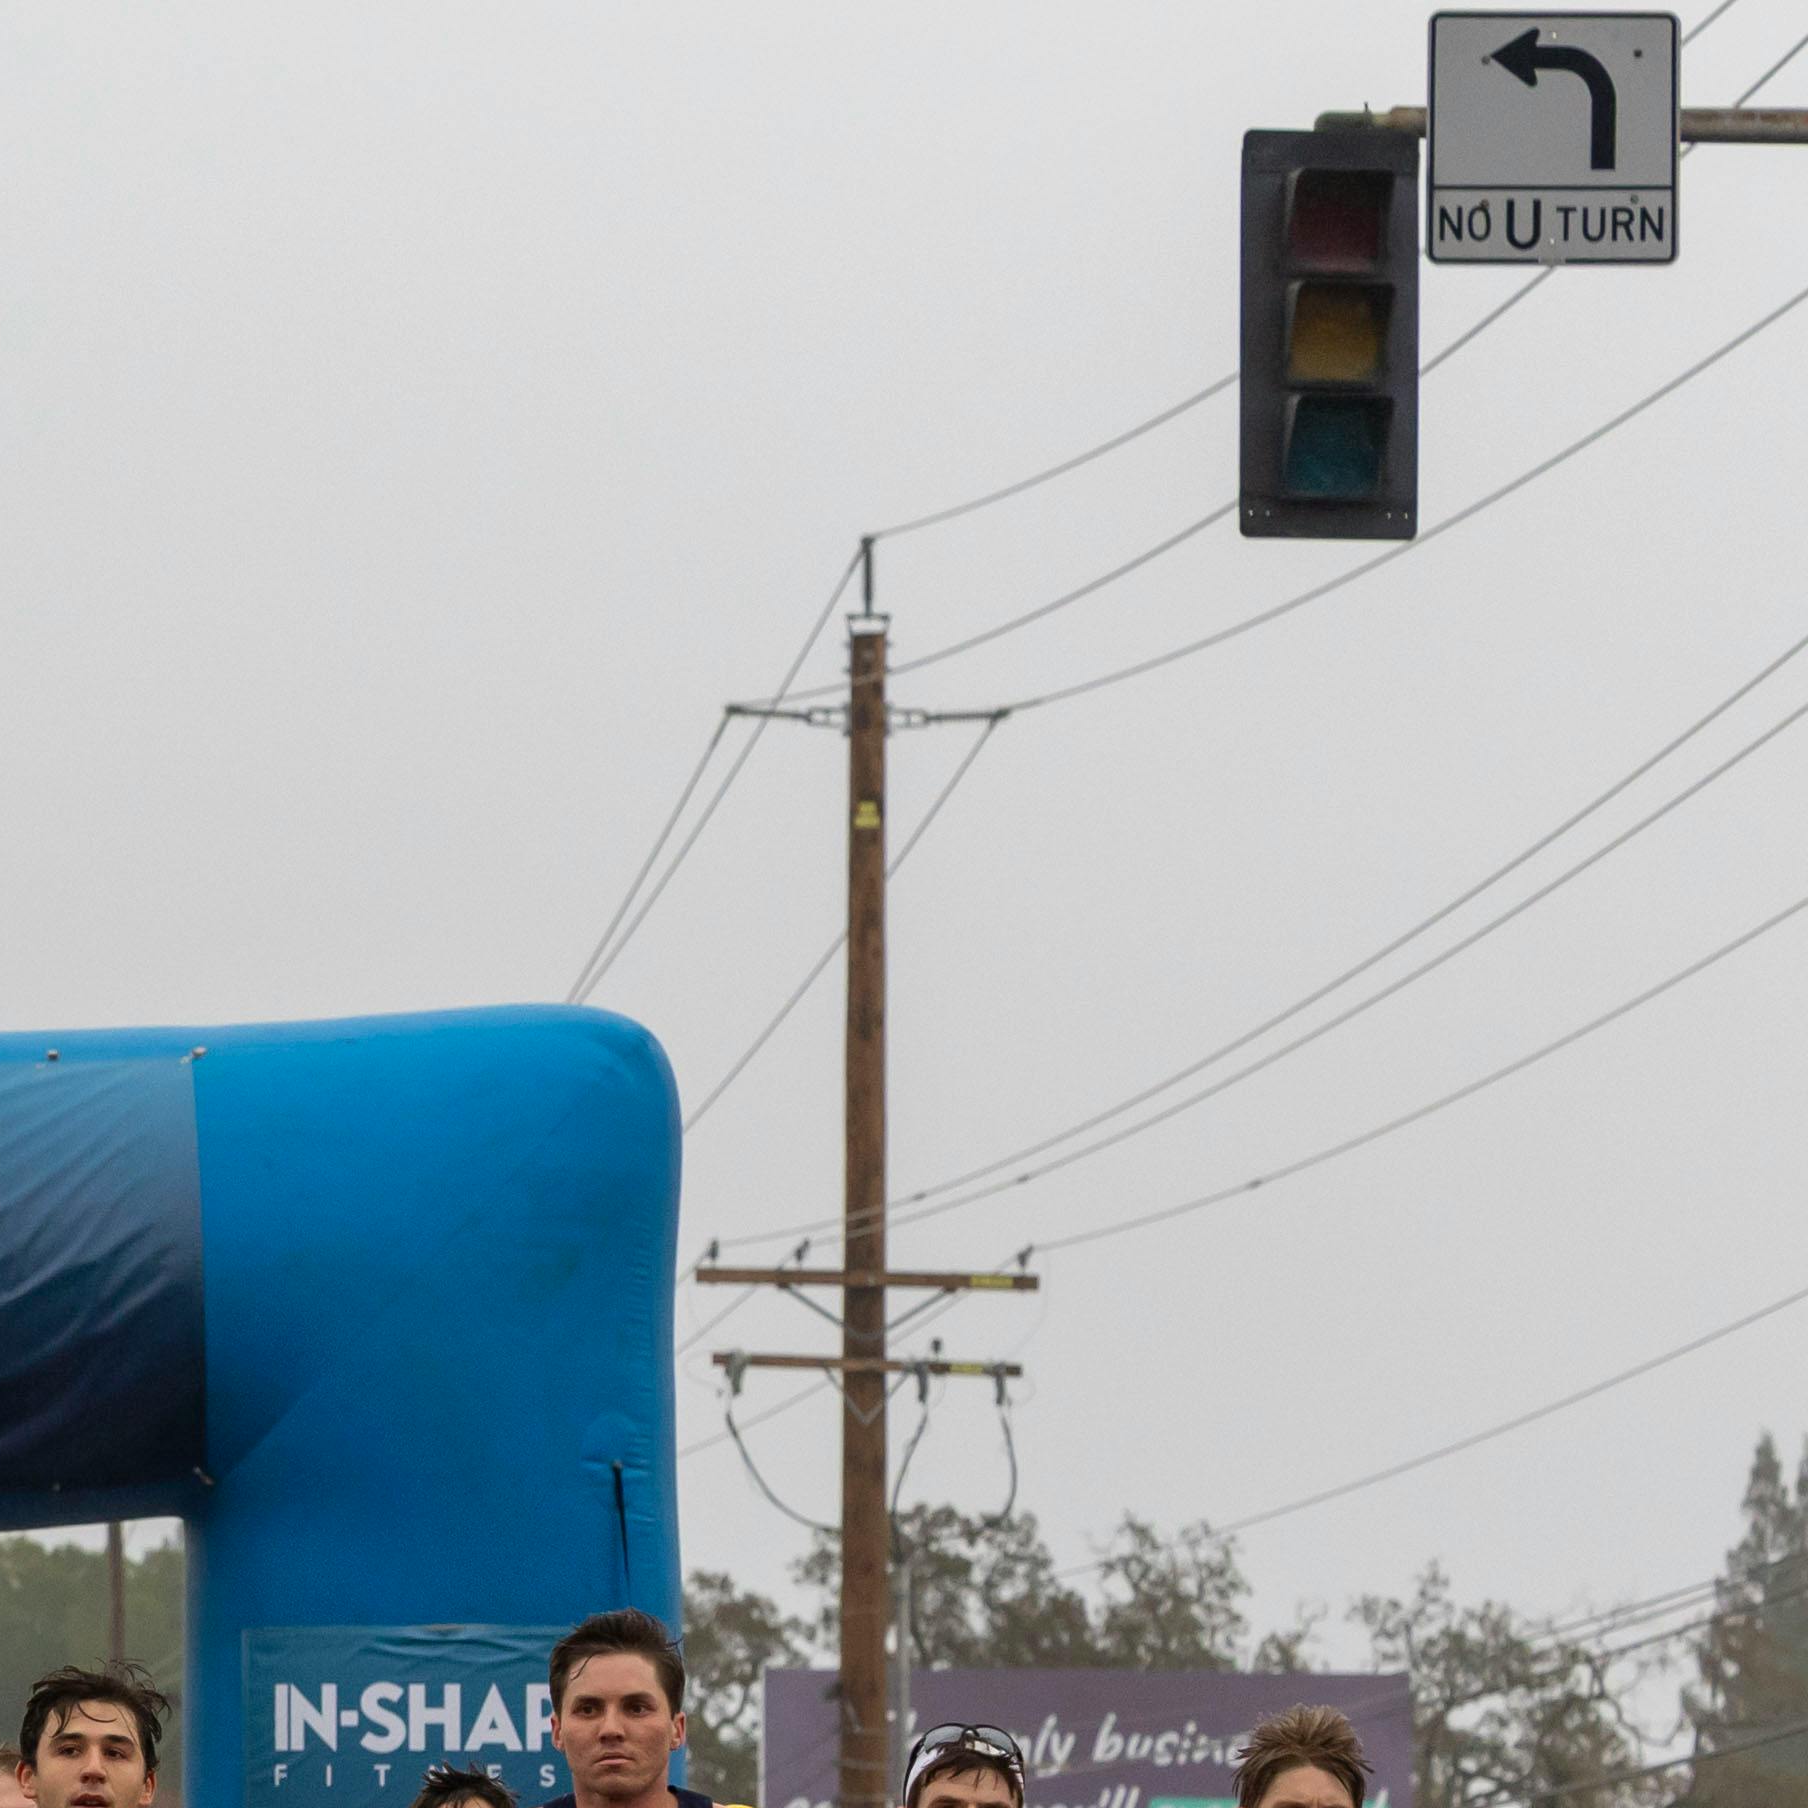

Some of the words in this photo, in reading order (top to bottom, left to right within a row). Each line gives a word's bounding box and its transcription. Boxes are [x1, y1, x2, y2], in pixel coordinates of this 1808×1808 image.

[1439, 205, 1491, 242] NO
[1506, 199, 1541, 249] U
[1556, 206, 1664, 242] TURN
[275, 1682, 553, 1753] IN-SHAP
[1012, 1713, 1076, 1778] nly
[1092, 1711, 1254, 1768] busine
